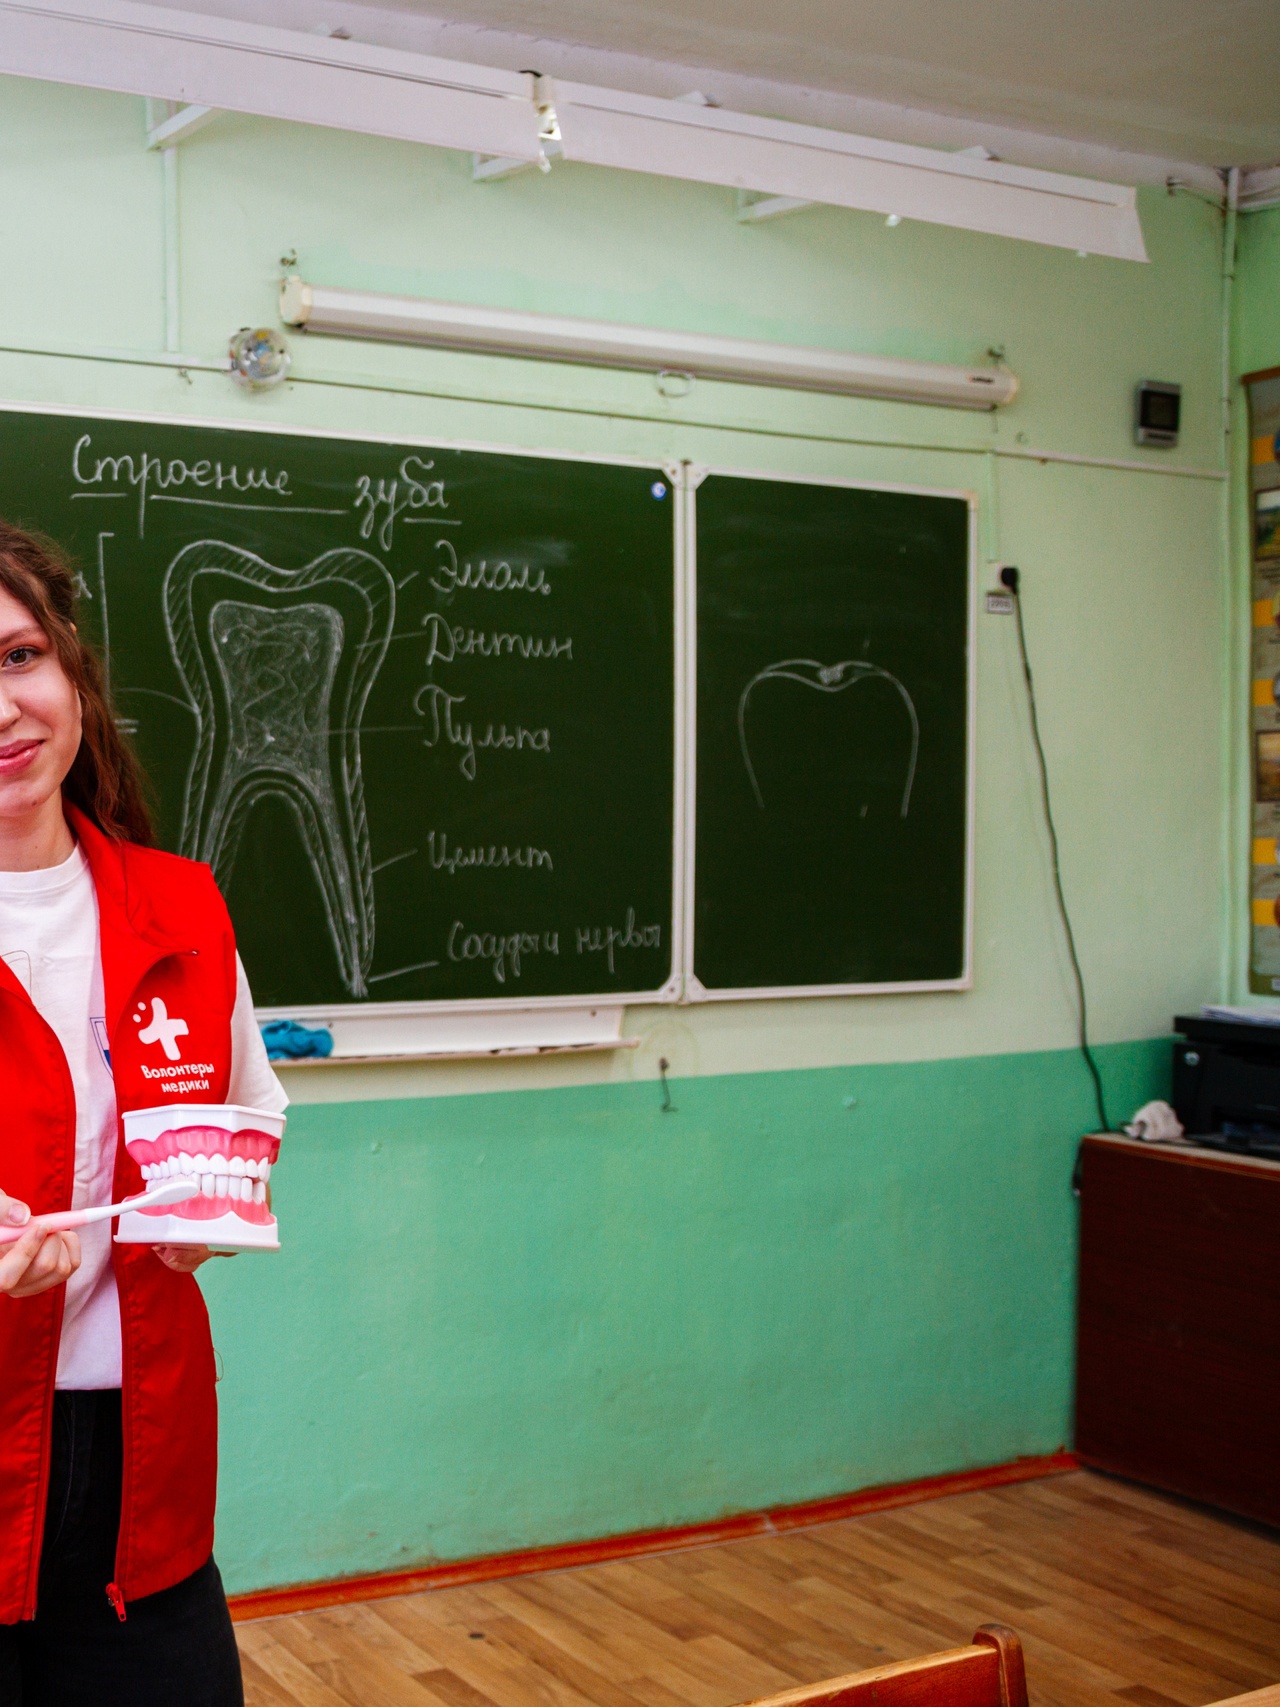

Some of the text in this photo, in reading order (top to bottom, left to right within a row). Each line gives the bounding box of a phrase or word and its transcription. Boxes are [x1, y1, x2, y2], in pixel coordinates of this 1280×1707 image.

[72, 434, 449, 551] Строение зуба
[429, 539, 552, 594] Эмаль
[422, 613, 573, 666] Дентин
[413, 684, 551, 780] Пульпа
[427, 830, 554, 875] Цемент
[575, 906, 661, 975] нервы
[140, 1063, 215, 1079] Волонтеры
[161, 1079, 210, 1094] медики
